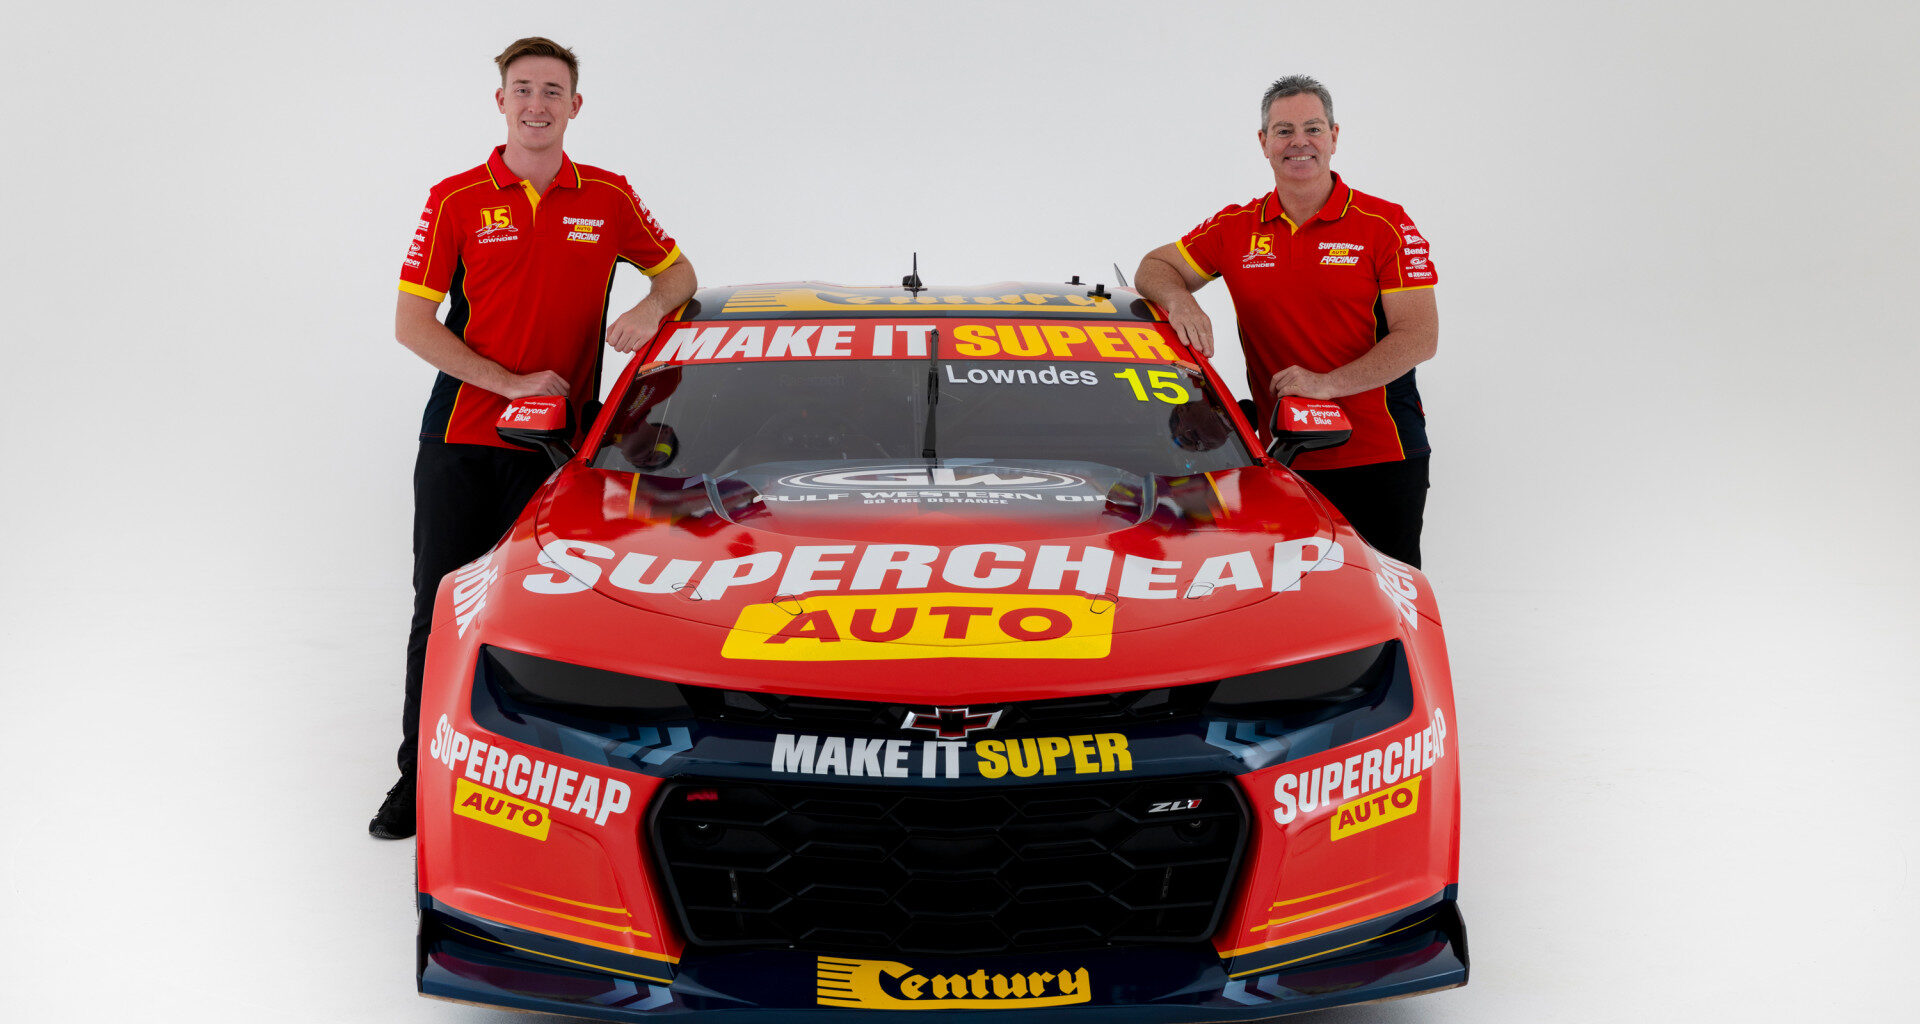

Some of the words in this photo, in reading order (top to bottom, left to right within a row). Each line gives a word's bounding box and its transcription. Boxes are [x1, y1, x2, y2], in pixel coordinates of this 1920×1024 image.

[482, 208, 510, 231] 15
[562, 216, 605, 228] SUPERCHEAP
[478, 235, 519, 244] LOWNDES
[567, 231, 600, 242] RACING
[1250, 235, 1271, 254] 15
[1317, 242, 1364, 251] SUPERCHEAP
[1320, 255, 1359, 265] RACING
[653, 325, 856, 362] MAKE
[872, 325, 937, 357] IT
[952, 324, 1181, 361] SUPER
[945, 364, 1099, 386] Lowndes
[1113, 368, 1190, 405] 15
[514, 413, 532, 422] Blue
[518, 406, 549, 415] Beyond
[1309, 409, 1341, 418] Beyond
[1313, 416, 1333, 425] Blue
[753, 493, 850, 503] GULF
[860, 491, 1042, 500] WESTERN
[522, 536, 1345, 600] SUPERCHEAP
[763, 606, 1073, 643] AUTO
[771, 733, 912, 778] MAKE
[922, 741, 967, 779] IT
[975, 732, 1134, 779] SUPER
[430, 713, 631, 827] SUPERCHEAP
[1273, 707, 1448, 825] SUPERCHEAP
[461, 792, 543, 828] AUTO
[1148, 799, 1202, 813] ZL1
[1338, 787, 1413, 830] AUTO
[835, 958, 1091, 1010] Century
